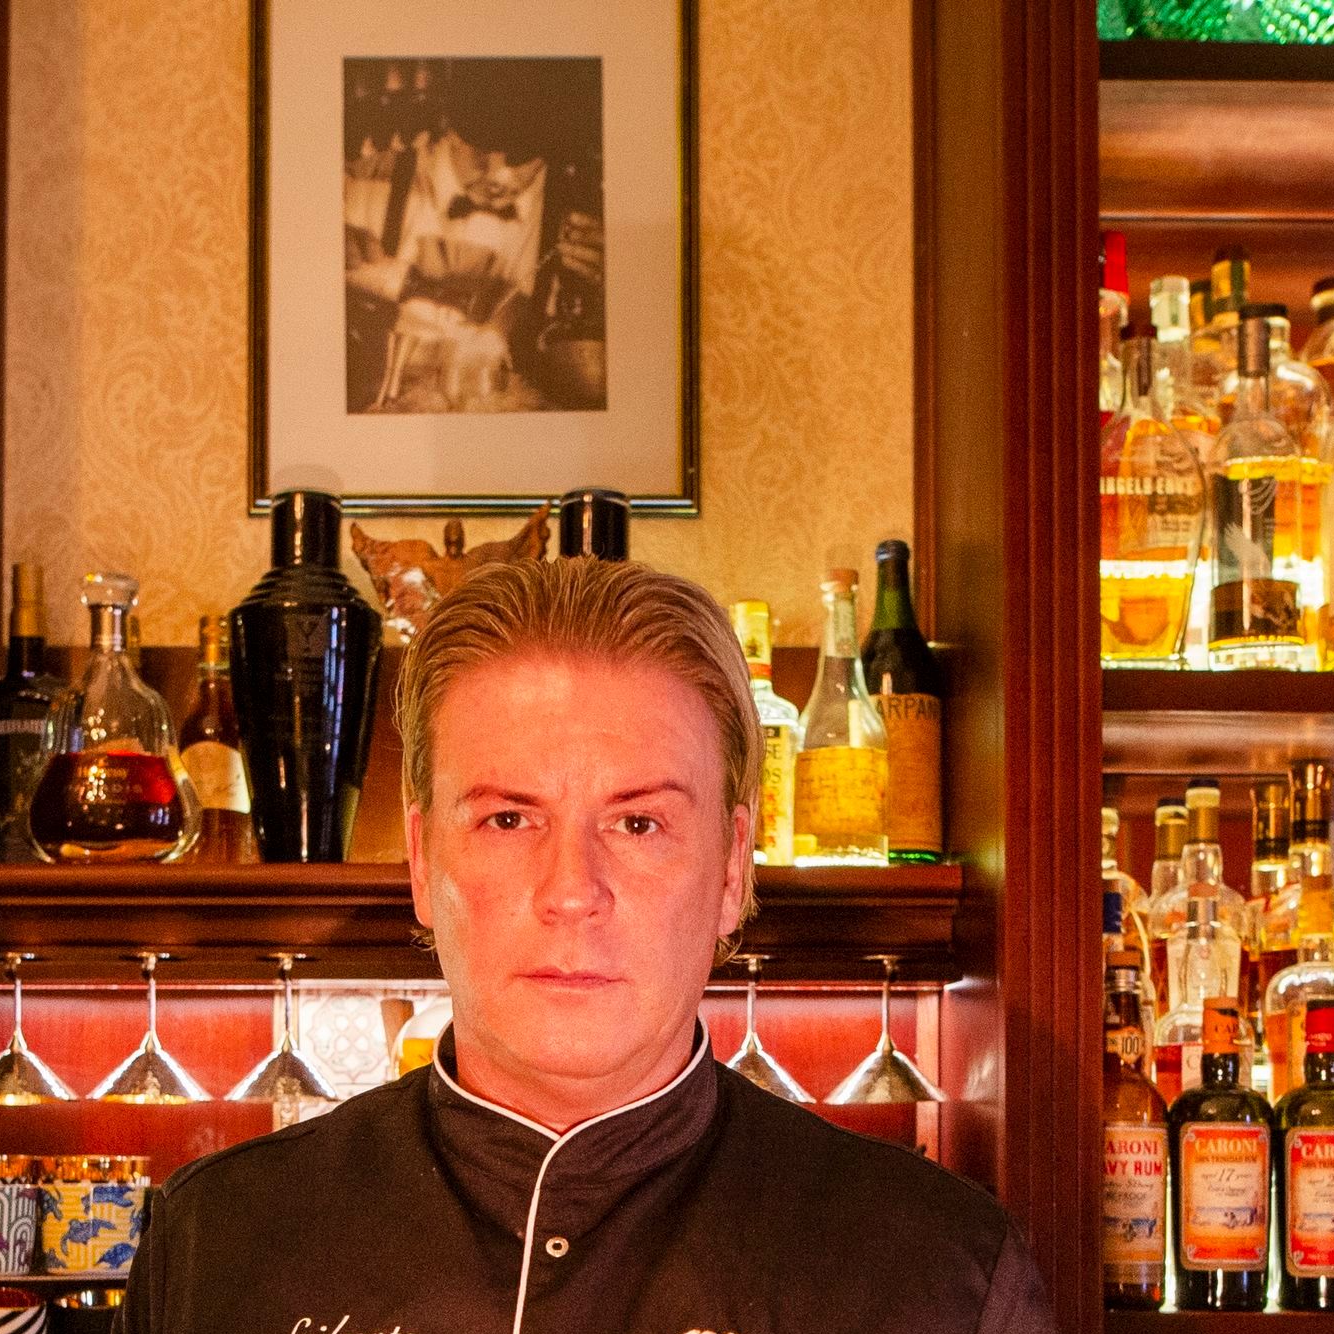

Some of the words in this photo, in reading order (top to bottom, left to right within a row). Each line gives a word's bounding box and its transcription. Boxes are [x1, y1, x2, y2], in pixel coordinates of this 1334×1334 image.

[1194, 1137, 1259, 1153] CARONI
[1133, 1160, 1164, 1176] RUM
[1218, 1168, 1236, 1183] 17
